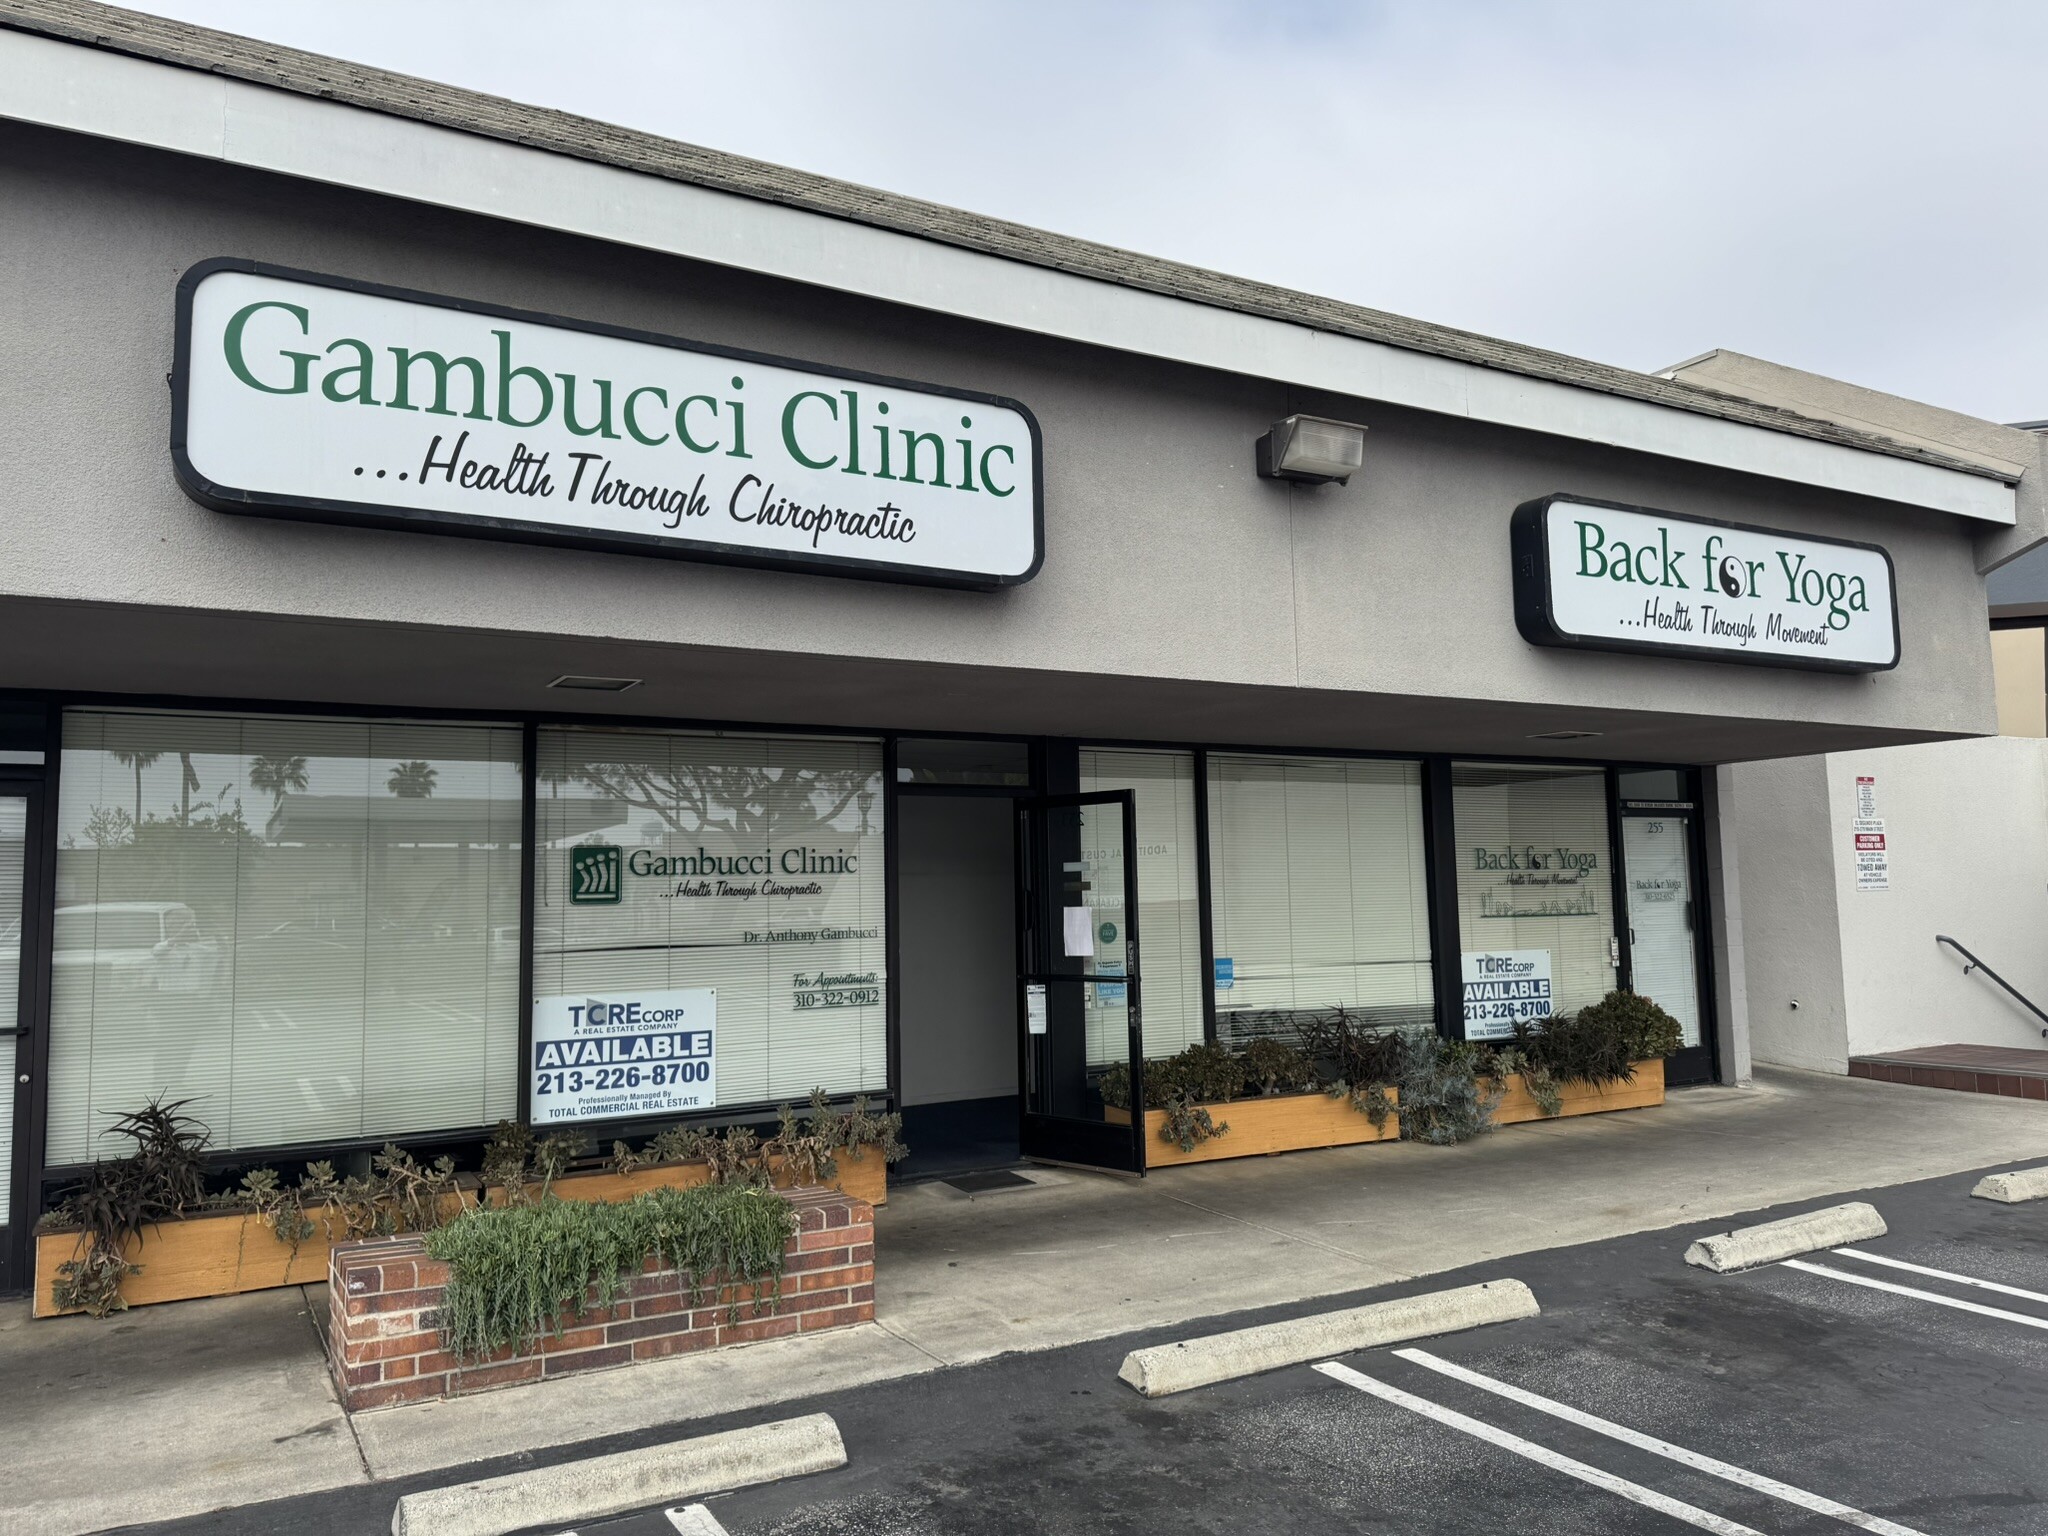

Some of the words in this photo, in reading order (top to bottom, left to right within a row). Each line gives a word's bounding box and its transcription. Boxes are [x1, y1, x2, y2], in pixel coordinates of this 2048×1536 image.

[222, 300, 753, 459] Gambucci
[780, 390, 1017, 498] Clinic
[568, 452, 710, 529] Through
[729, 474, 916, 548] Chiropractic
[1573, 520, 1690, 590] Back
[1702, 535, 1765, 599] for
[1775, 551, 1869, 631] Yoga
[1700, 605, 1757, 647] Through
[1765, 613, 1829, 646] Movement
[1647, 822, 1664, 833] 255
[629, 848, 773, 876] Gambucci
[781, 847, 857, 874] Clinic
[1474, 845, 1520, 870] Back
[1557, 848, 1598, 878] Yoga
[716, 880, 757, 900] Through
[761, 879, 822, 900] Chiropractic
[1636, 879, 1653, 889] Back
[1666, 878, 1682, 891] Yoga
[744, 931, 762, 942] Dr.
[765, 929, 818, 944] Anthony
[821, 926, 878, 940] Gambucci
[793, 973, 810, 987] For
[1463, 981, 1549, 1000] AVAILABLE
[794, 990, 879, 1008] 310-322-0912
[1464, 1000, 1550, 1020] 213-226-8700
[607, 1025, 634, 1033] ESTATE
[638, 1023, 678, 1032] COMPANY
[538, 1033, 710, 1067] AVAILABLE
[537, 1061, 710, 1095] 213-226-8700
[549, 1107, 578, 1118] TOTAL
[580, 1101, 640, 1115] COMMERCIAL
[642, 1099, 664, 1110] REAL
[667, 1097, 699, 1108] ESTATE
[578, 1094, 628, 1105] Professionally
[630, 1092, 660, 1101] Managed
[663, 1091, 671, 1099] By
